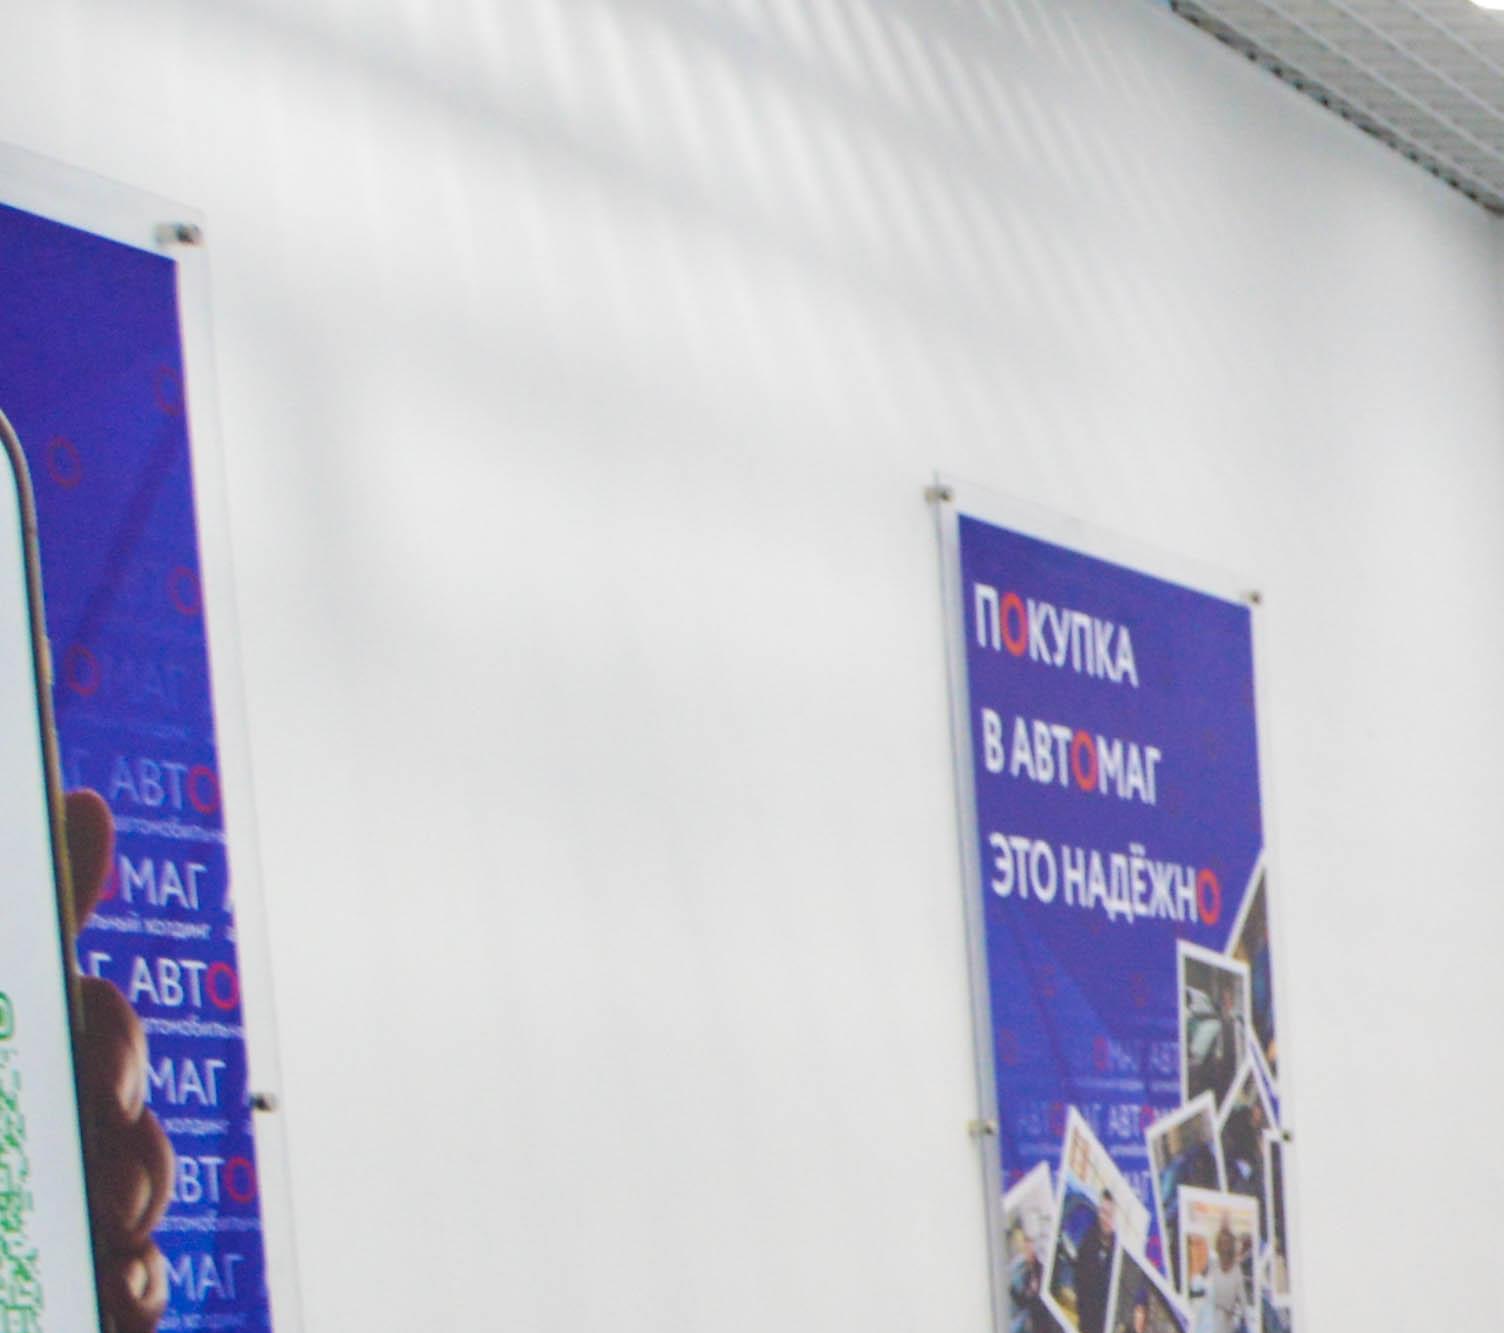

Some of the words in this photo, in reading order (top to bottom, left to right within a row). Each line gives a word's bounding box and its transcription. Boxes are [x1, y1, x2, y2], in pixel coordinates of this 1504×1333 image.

[973, 580, 1139, 688] ПОКУПКА
[980, 707, 1003, 775] В
[1009, 710, 1162, 805] АВТОМАГ
[988, 832, 1056, 905] ЭТО
[1063, 842, 1222, 926] НАДЁЖНО
